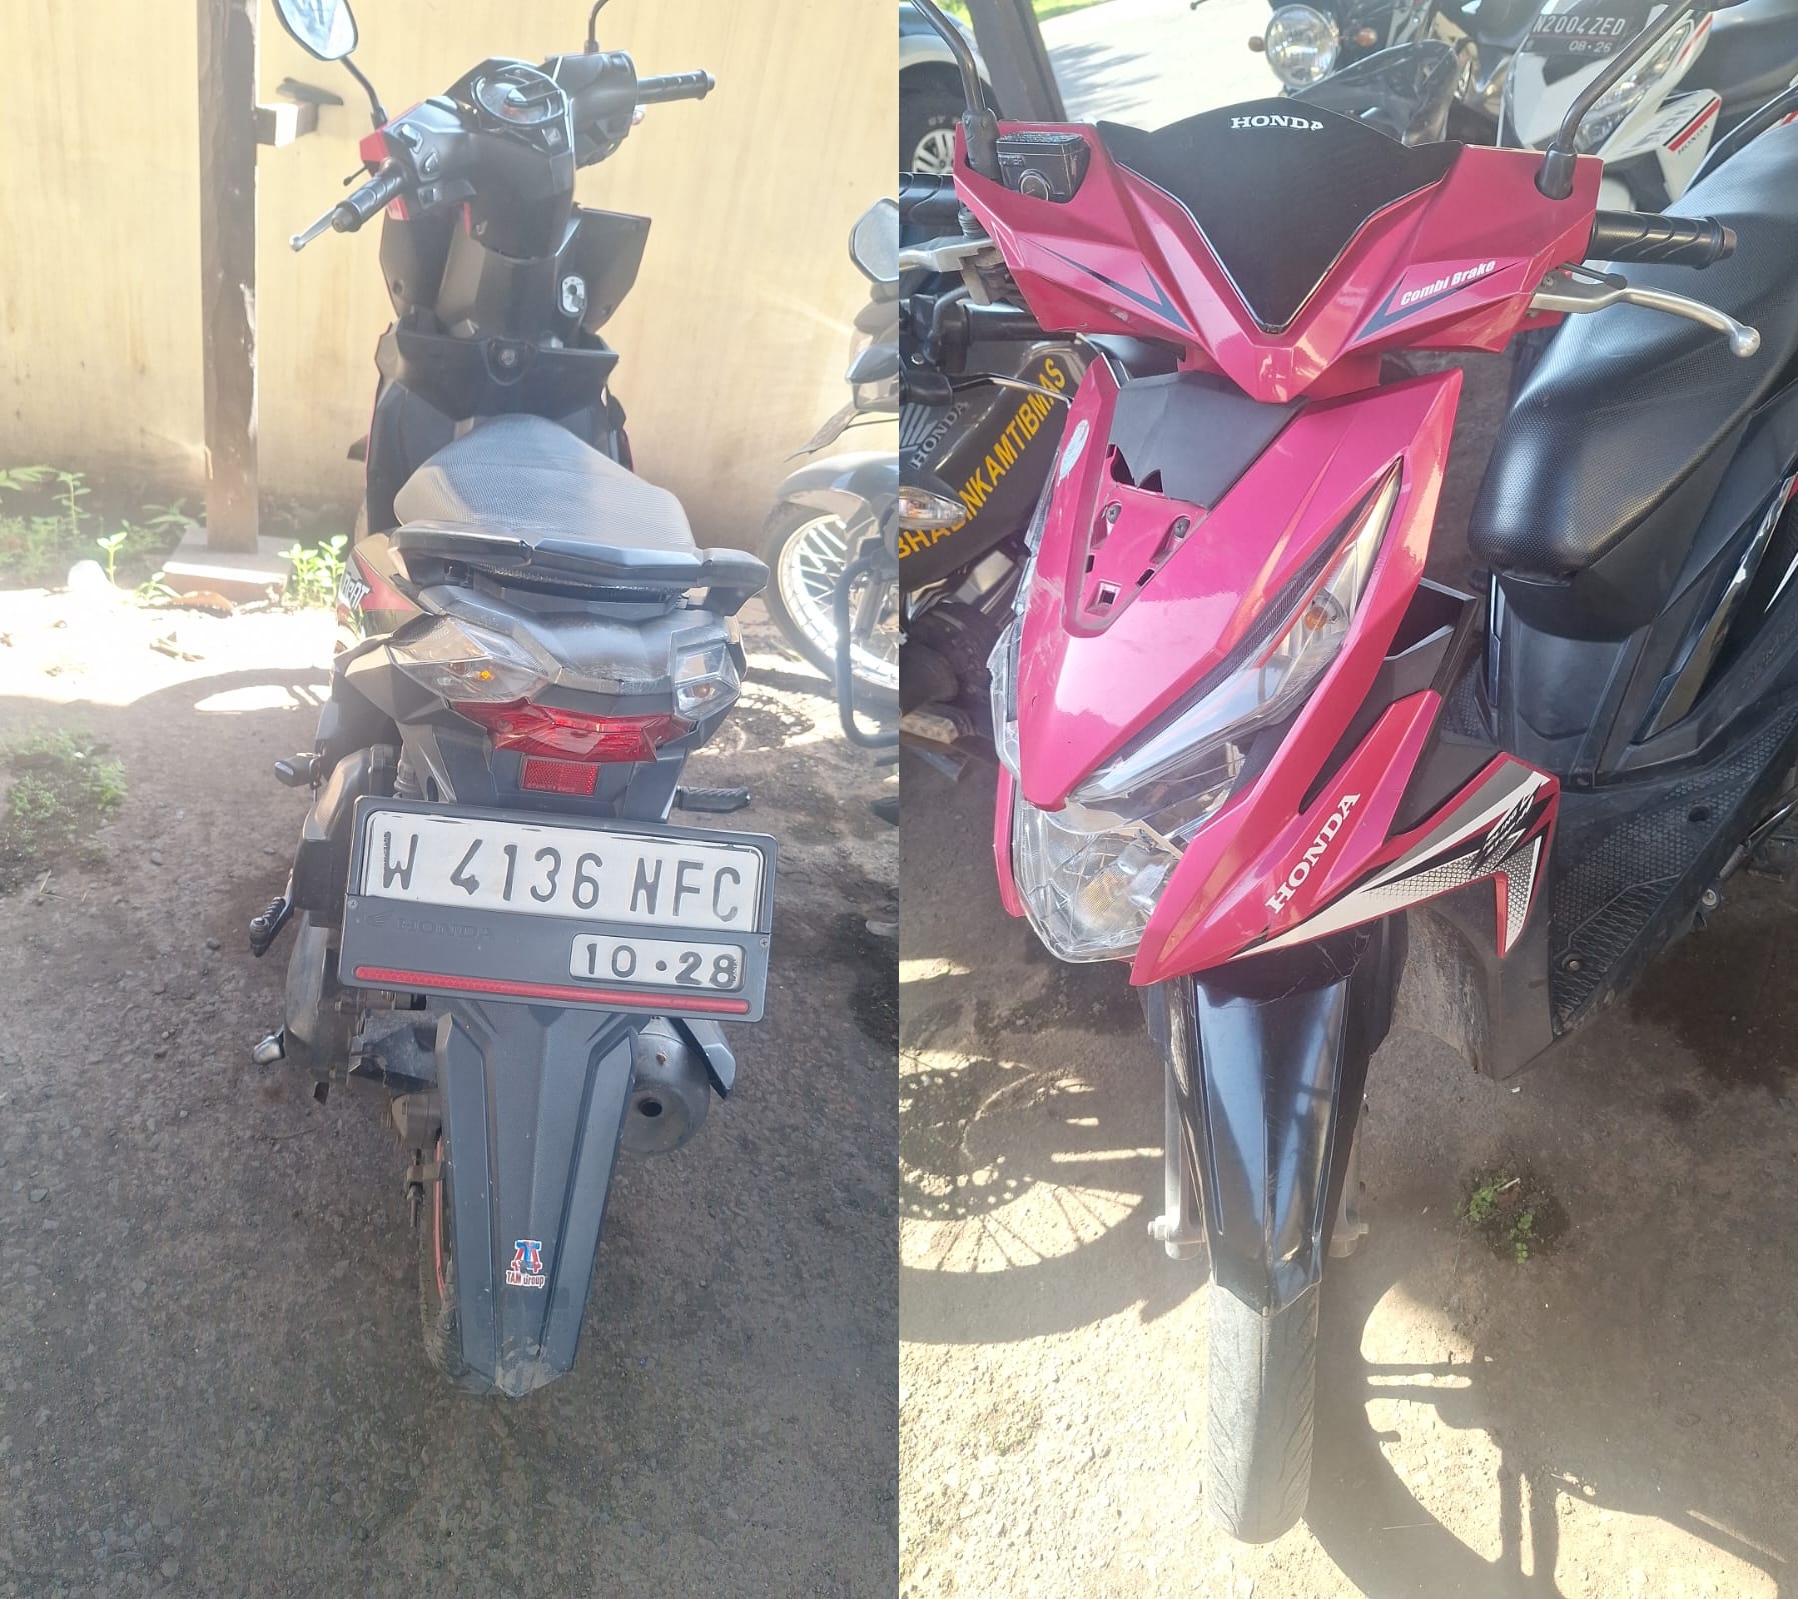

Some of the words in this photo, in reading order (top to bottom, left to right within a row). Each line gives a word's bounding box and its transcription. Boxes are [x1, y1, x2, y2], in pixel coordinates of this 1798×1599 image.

[1231, 115, 1324, 131] HONDA
[1401, 276, 1450, 306] Combi
[1451, 260, 1496, 286] Brake
[911, 400, 969, 470] HONDA
[382, 830, 419, 890] W
[449, 839, 603, 910] 4136
[629, 857, 741, 923] NFC
[1265, 793, 1361, 914] HONDA
